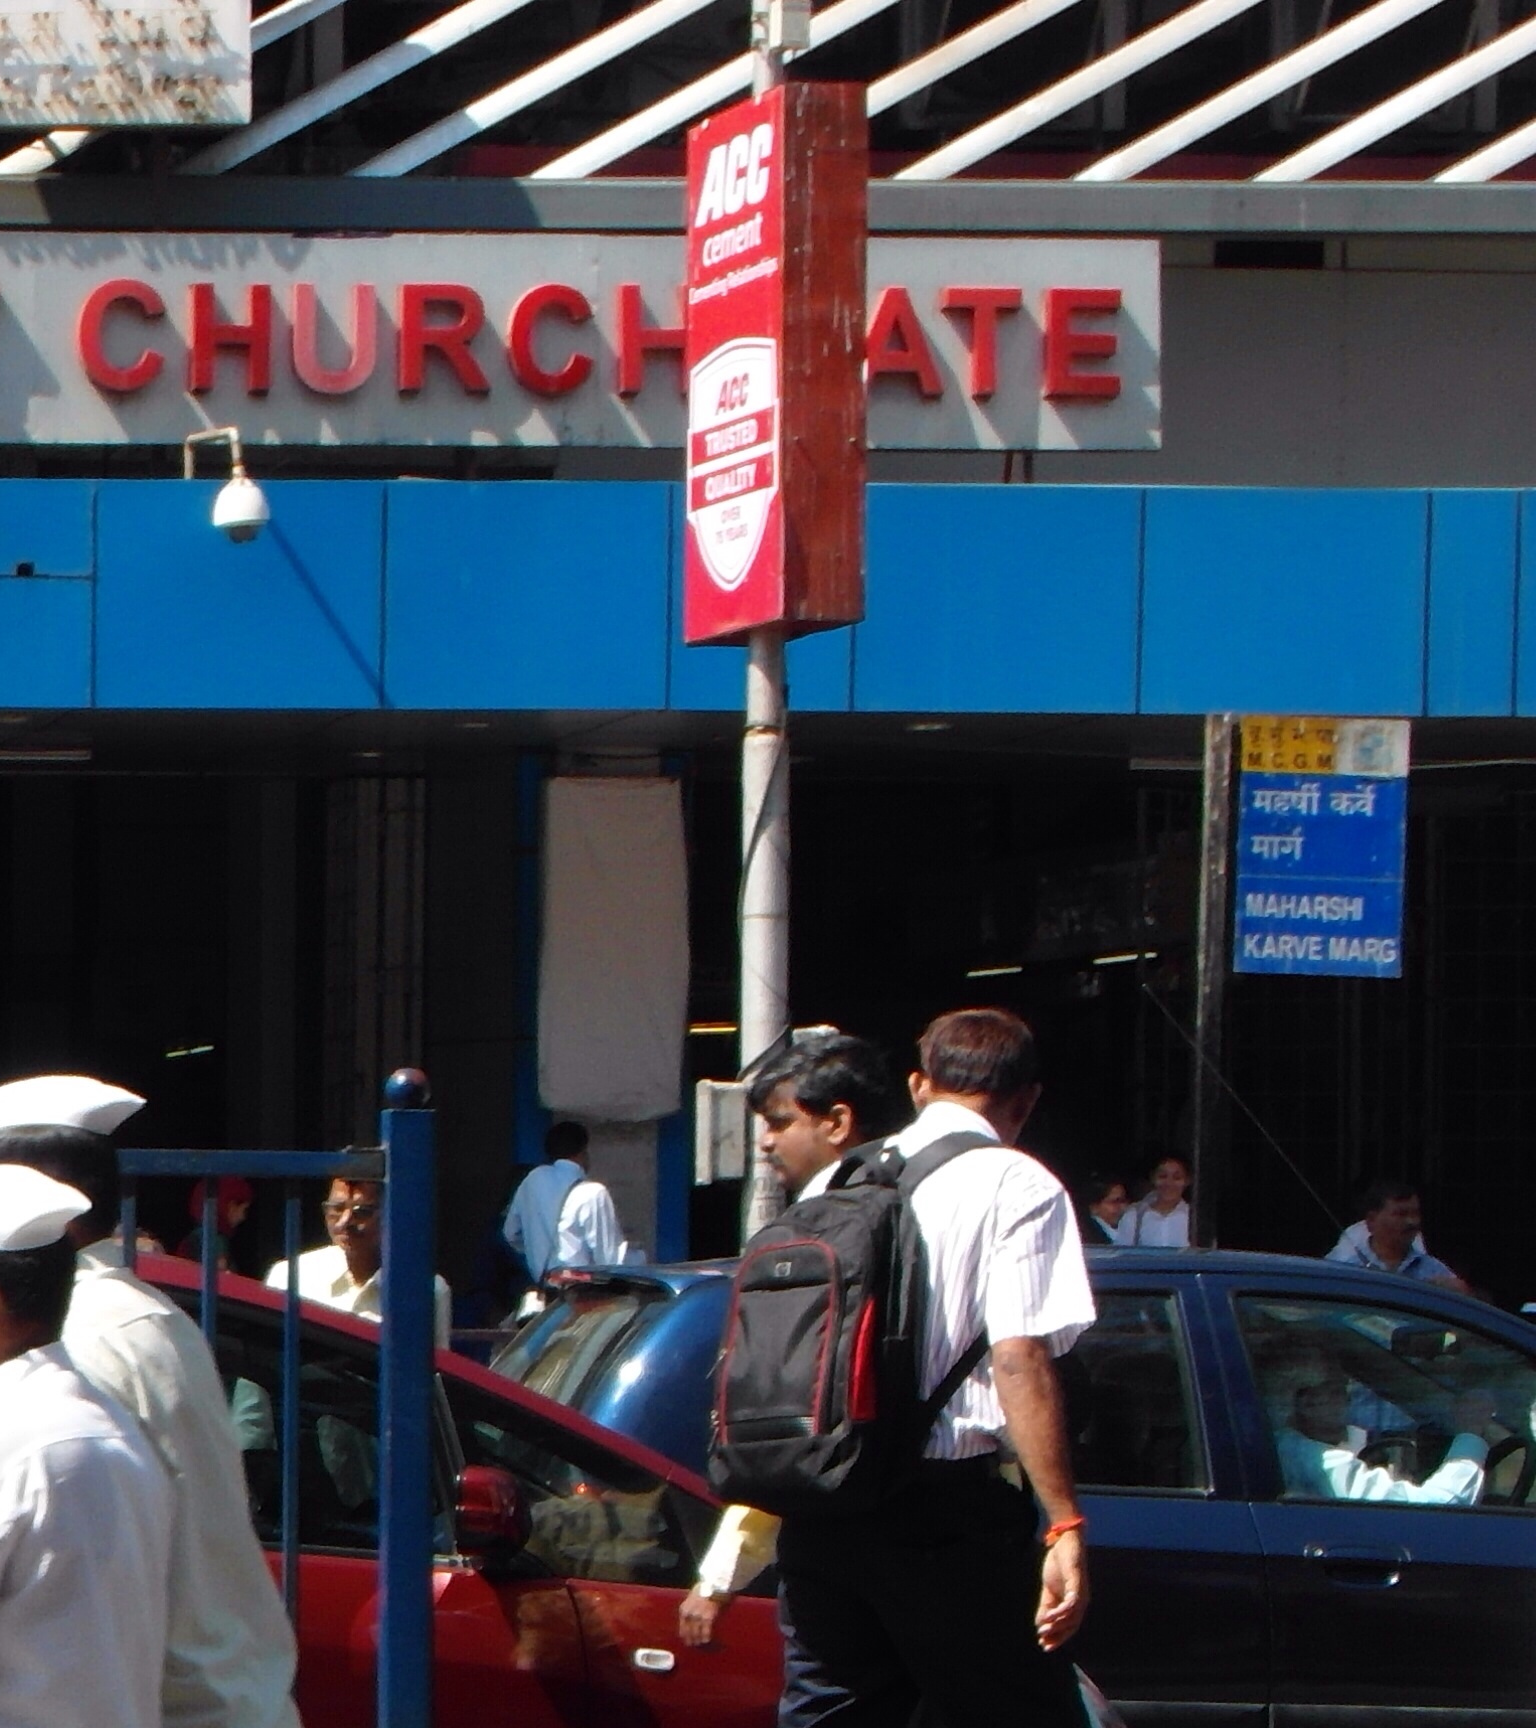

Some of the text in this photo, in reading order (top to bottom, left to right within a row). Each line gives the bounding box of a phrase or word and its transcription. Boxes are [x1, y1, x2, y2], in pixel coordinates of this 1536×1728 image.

[694, 123, 773, 228] ACC
[702, 211, 763, 267] cement
[78, 279, 1123, 399] CHURCHATE
[716, 373, 749, 416] ACC
[705, 418, 758, 457] TRUSTED
[705, 463, 757, 502] QUALITY
[1250, 827, 1304, 861] मार्ग
[1245, 893, 1364, 922] MAHARSHI
[1243, 934, 1397, 963] KARVE MARG
